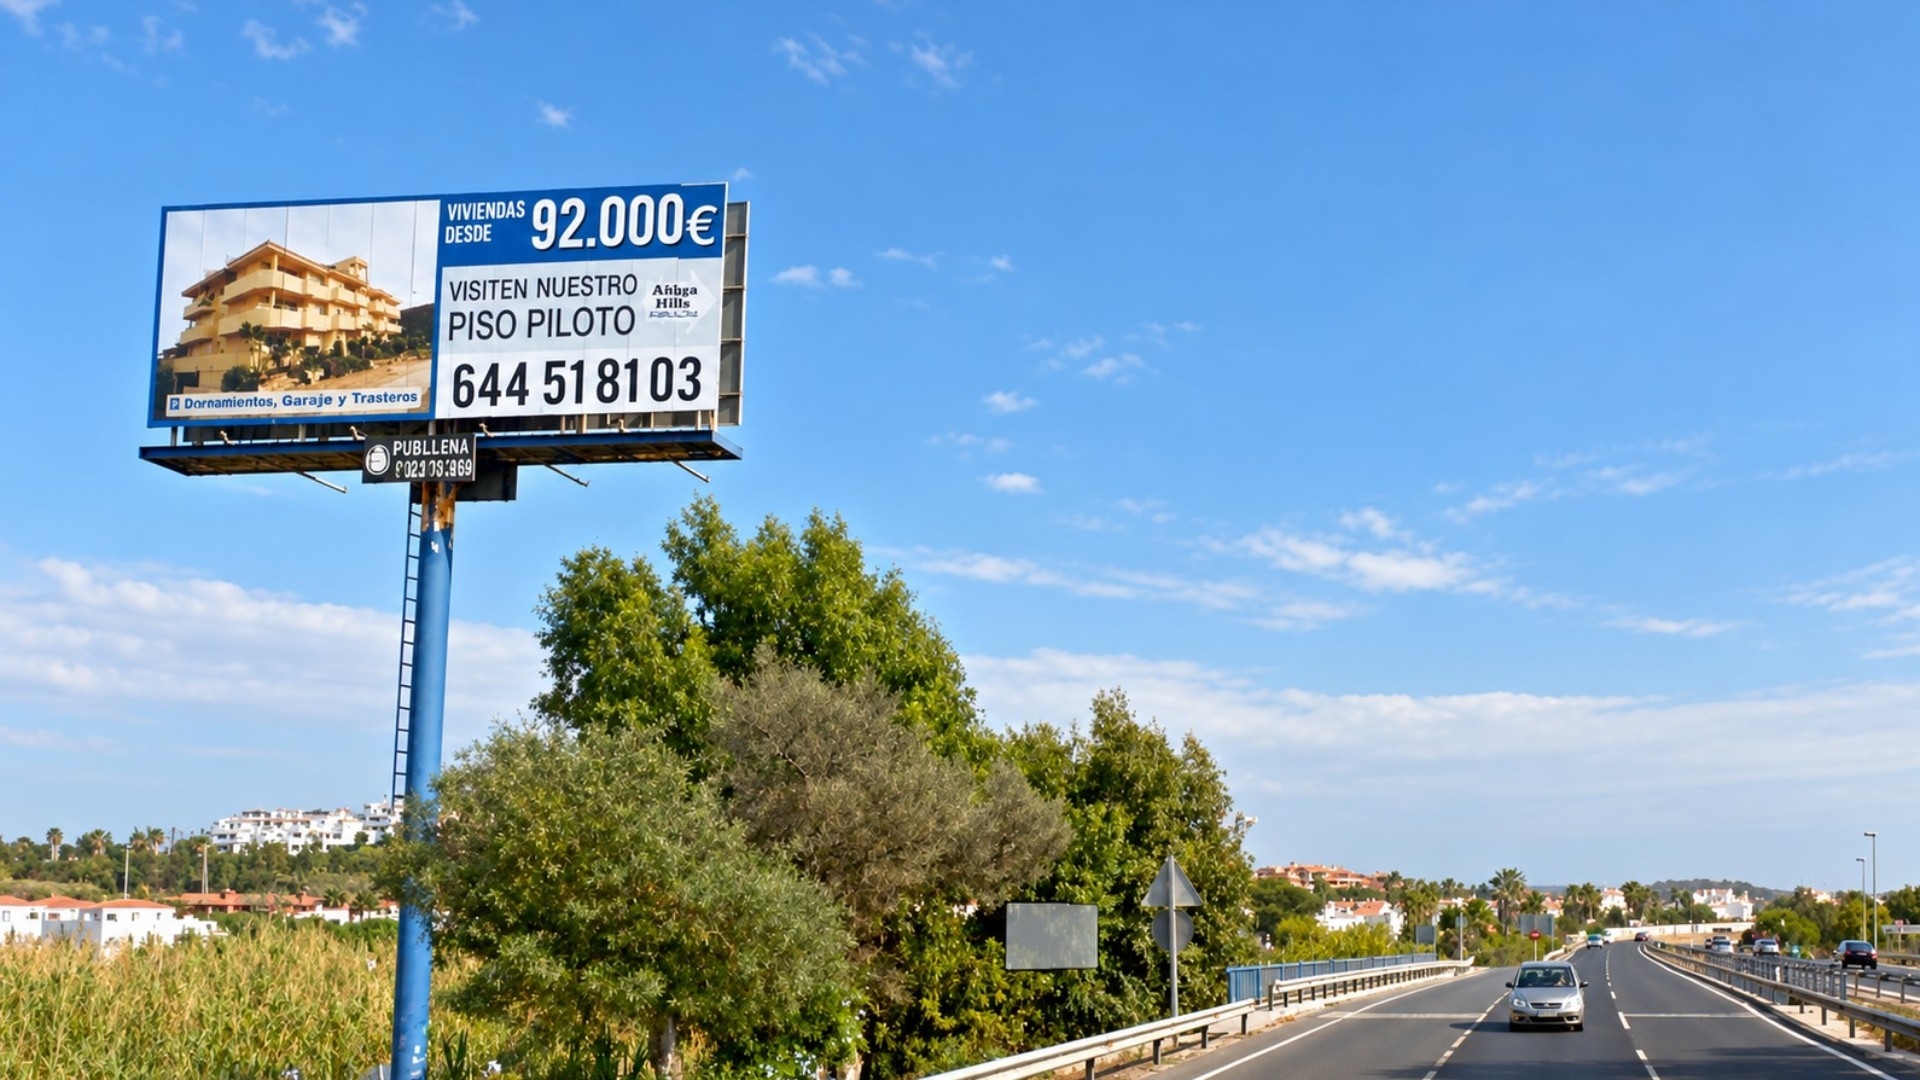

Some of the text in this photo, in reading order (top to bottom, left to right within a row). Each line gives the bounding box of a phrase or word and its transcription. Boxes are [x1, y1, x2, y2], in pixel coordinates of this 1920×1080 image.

[448, 201, 525, 220] VIVIENDAS
[446, 224, 491, 243] DESDE
[450, 274, 637, 301] VISITEN NUESTRO
[656, 298, 690, 308] Hills
[449, 306, 635, 341] PISO PILOTO
[453, 362, 529, 408] 644
[282, 394, 332, 407] Garaje
[338, 395, 347, 407] y
[352, 392, 418, 404] Trasteros
